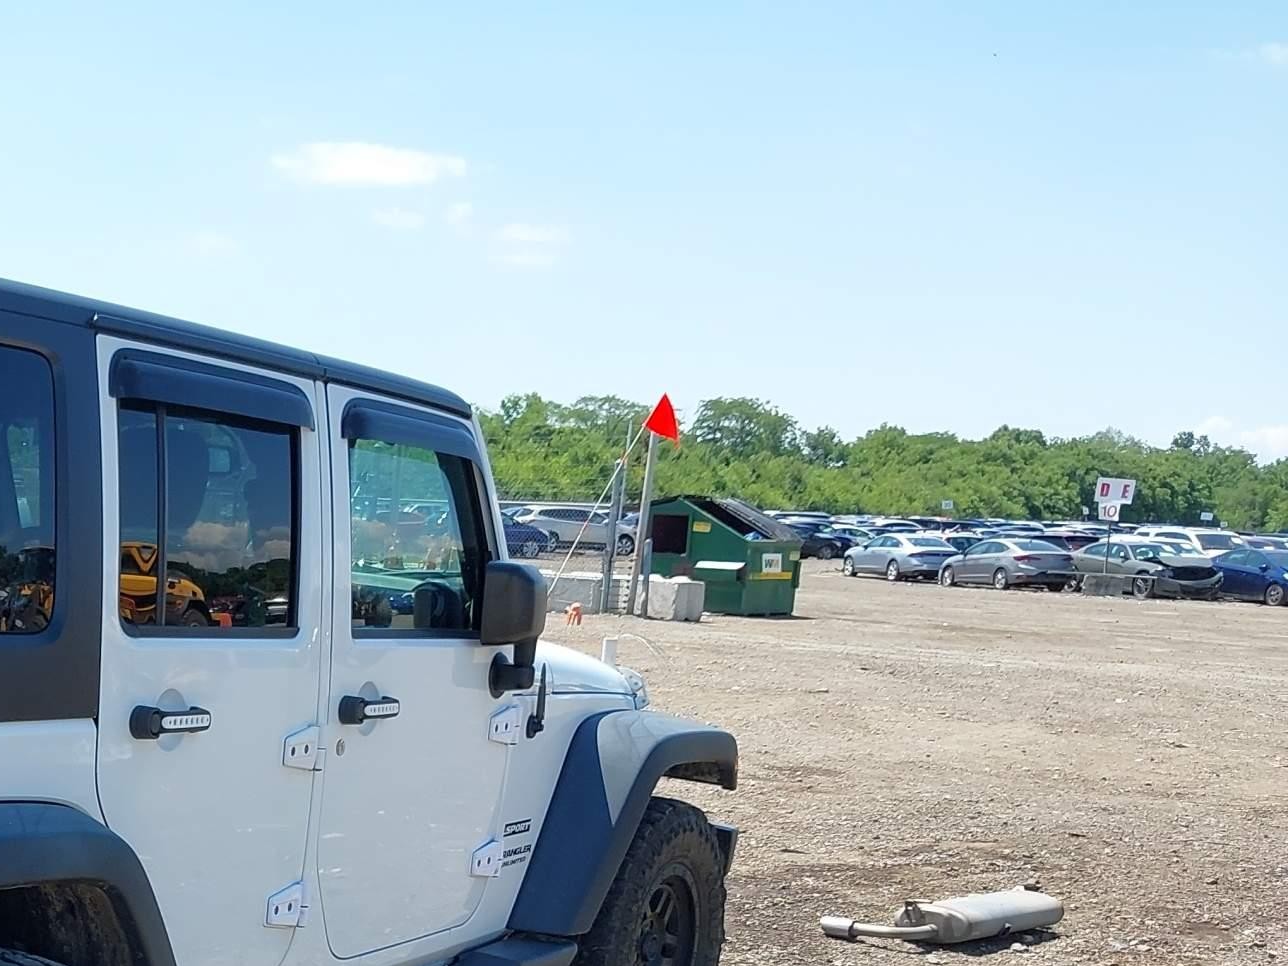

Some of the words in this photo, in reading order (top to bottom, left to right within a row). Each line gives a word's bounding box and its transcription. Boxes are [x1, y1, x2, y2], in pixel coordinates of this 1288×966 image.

[1099, 482, 1111, 497] D
[1121, 484, 1131, 499] E
[1102, 505, 1118, 518] 10
[506, 822, 530, 834] SPORT
[503, 844, 532, 858] RANGLER
